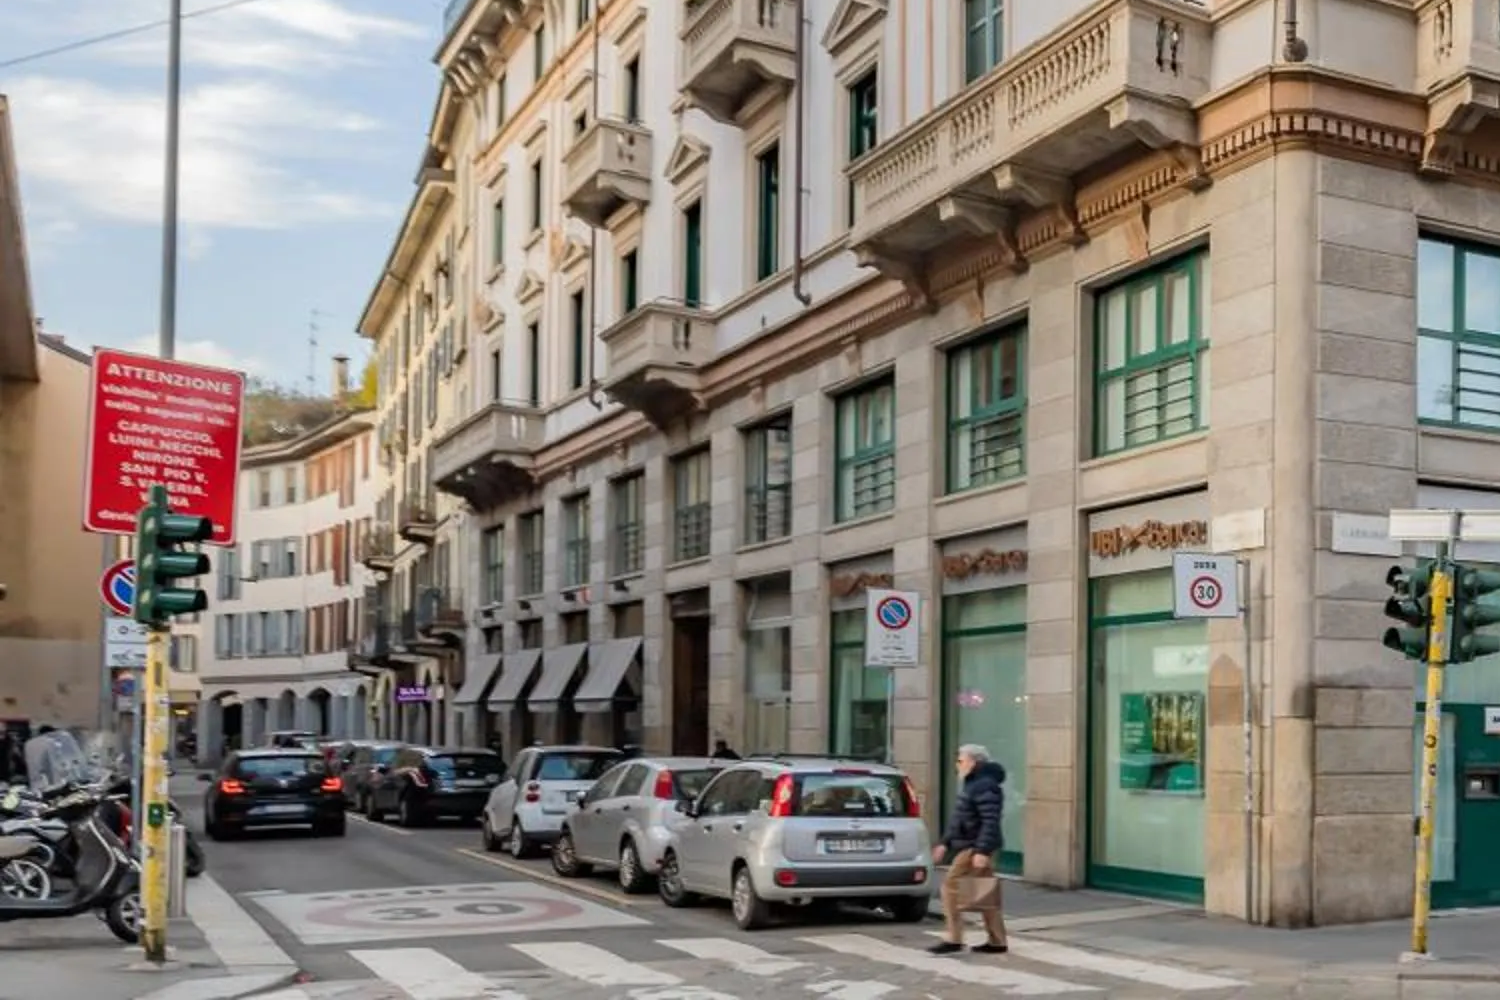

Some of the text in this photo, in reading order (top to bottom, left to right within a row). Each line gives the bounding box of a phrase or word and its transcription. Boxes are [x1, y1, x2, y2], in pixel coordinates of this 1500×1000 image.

[106, 362, 233, 395] ATTENZIONE
[120, 461, 157, 477] SAN
[163, 467, 192, 482] PIO
[1197, 585, 1216, 600] 30
